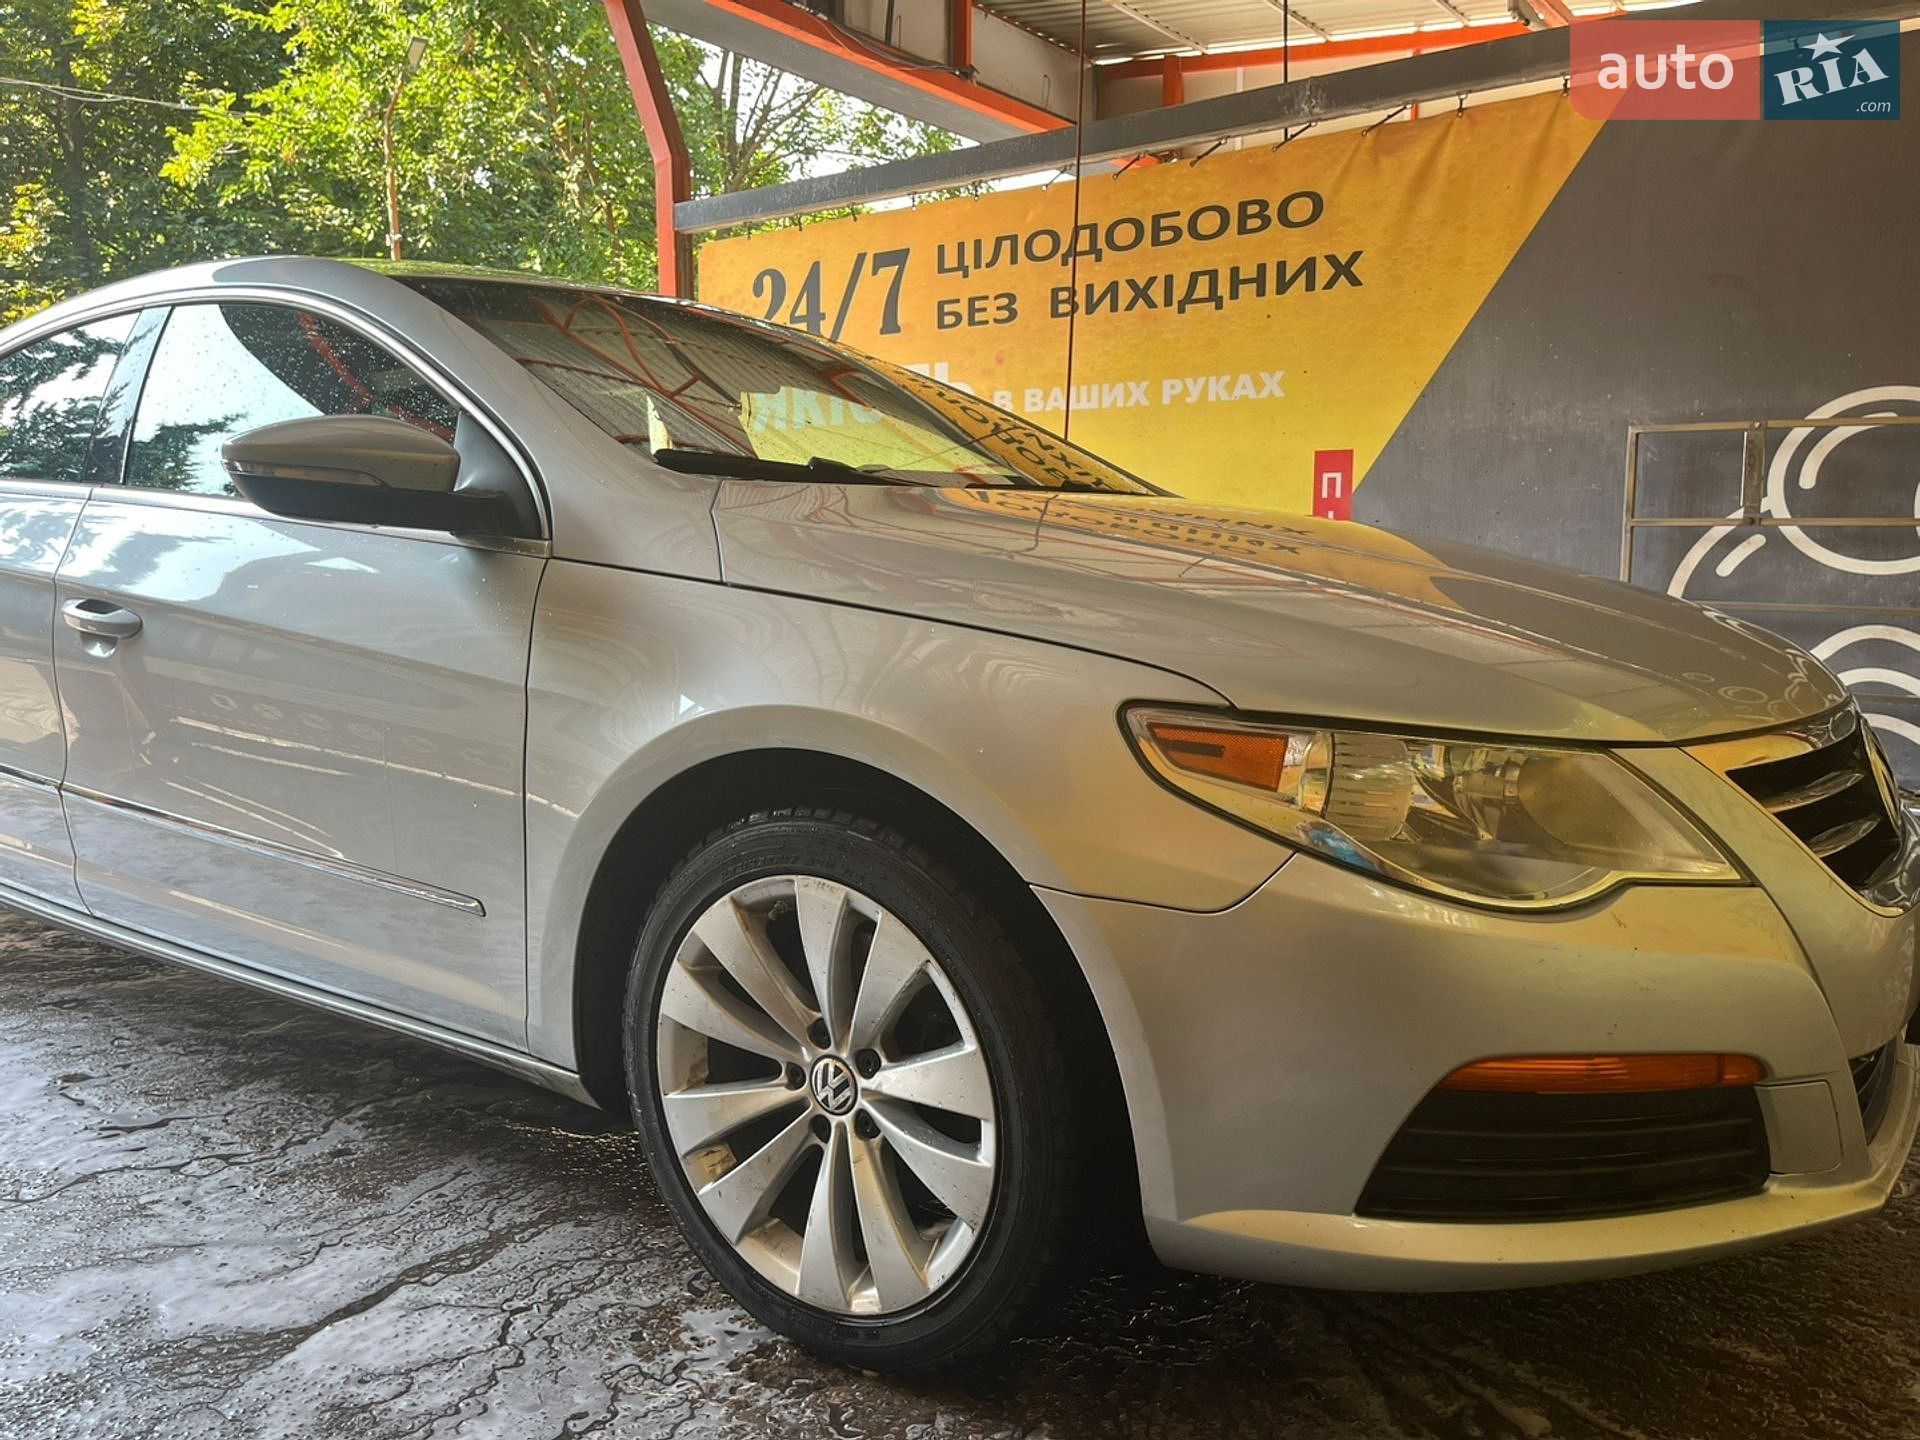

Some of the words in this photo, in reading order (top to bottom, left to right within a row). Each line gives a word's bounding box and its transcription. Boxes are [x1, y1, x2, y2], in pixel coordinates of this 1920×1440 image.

[937, 190, 1325, 278] ЦІЛОДОБОВО
[752, 248, 910, 342] 24/7
[937, 291, 1018, 330] БЕЗ
[1050, 250, 1364, 319] ВИХІДНИХ
[1023, 380, 1150, 413] ВАШИХ
[1161, 371, 1285, 405] РУКАХ
